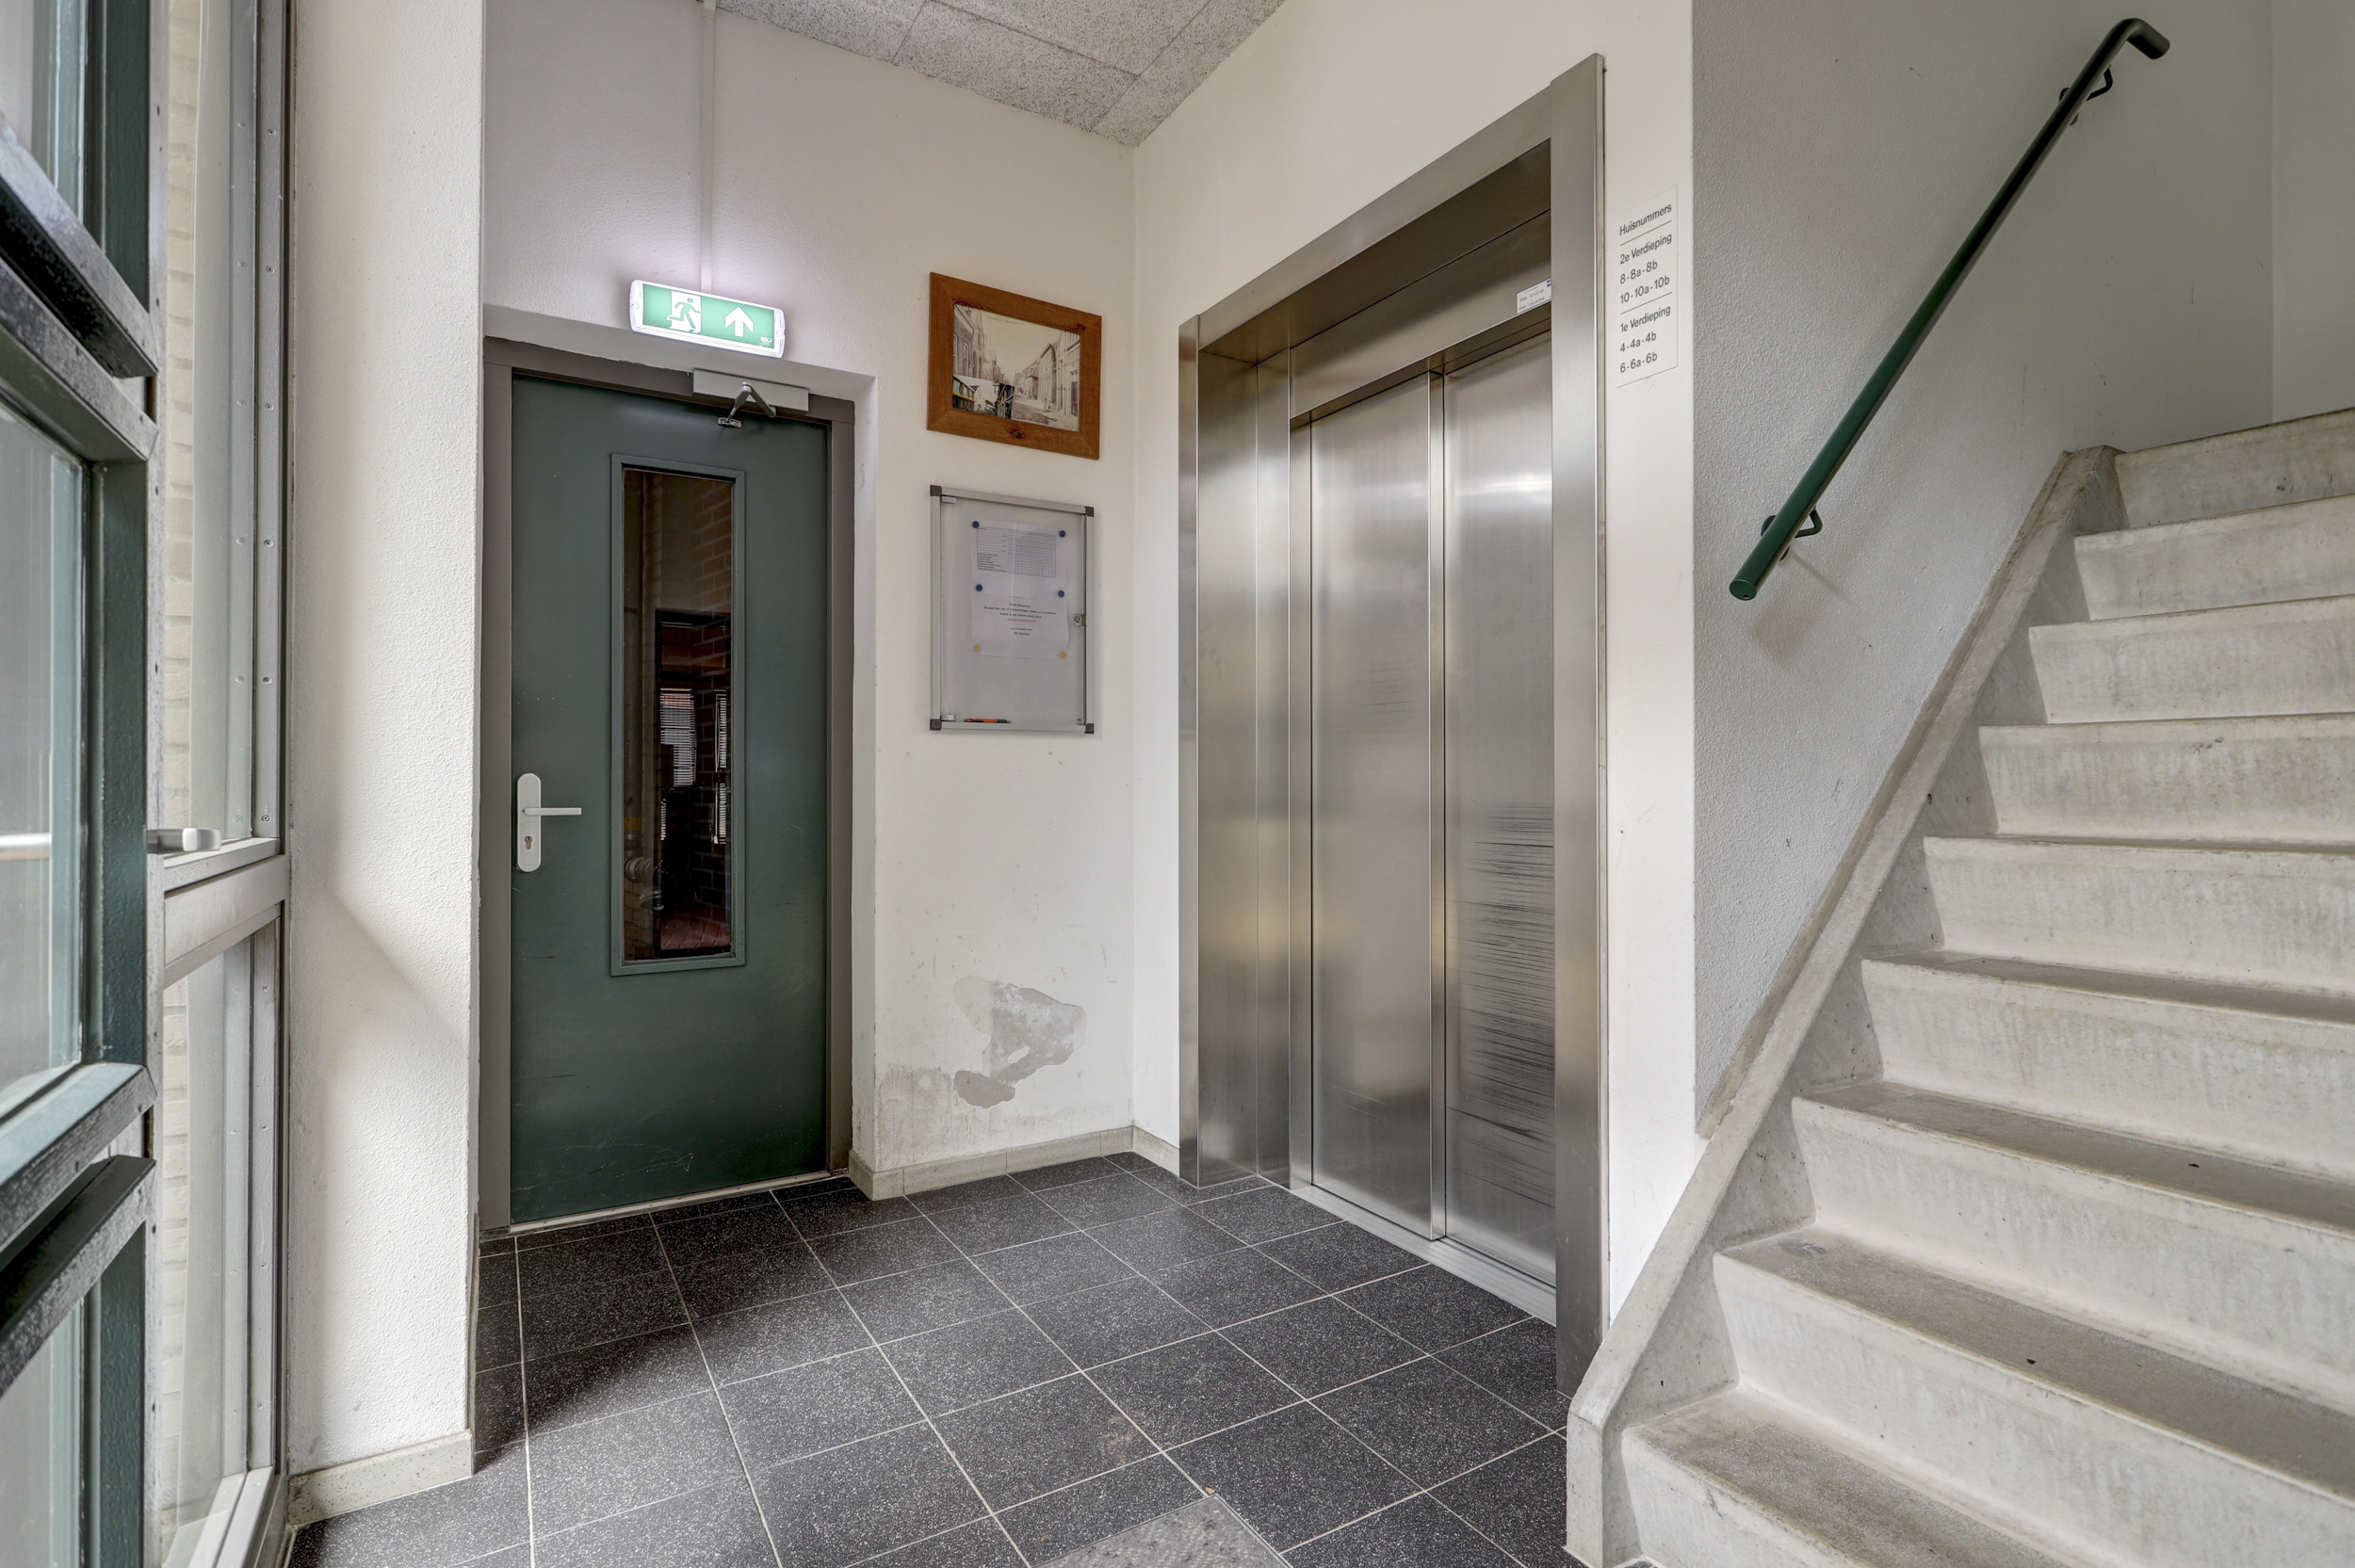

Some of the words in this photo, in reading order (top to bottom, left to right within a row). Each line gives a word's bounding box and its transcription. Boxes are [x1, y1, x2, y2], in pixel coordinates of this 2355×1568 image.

[1619, 203, 1672, 235] Huisnummers
[1619, 253, 1630, 266] 2e
[1631, 234, 1672, 259] Verdieping
[1620, 322, 1629, 332] 1e
[1630, 305, 1671, 329] Verdieping
